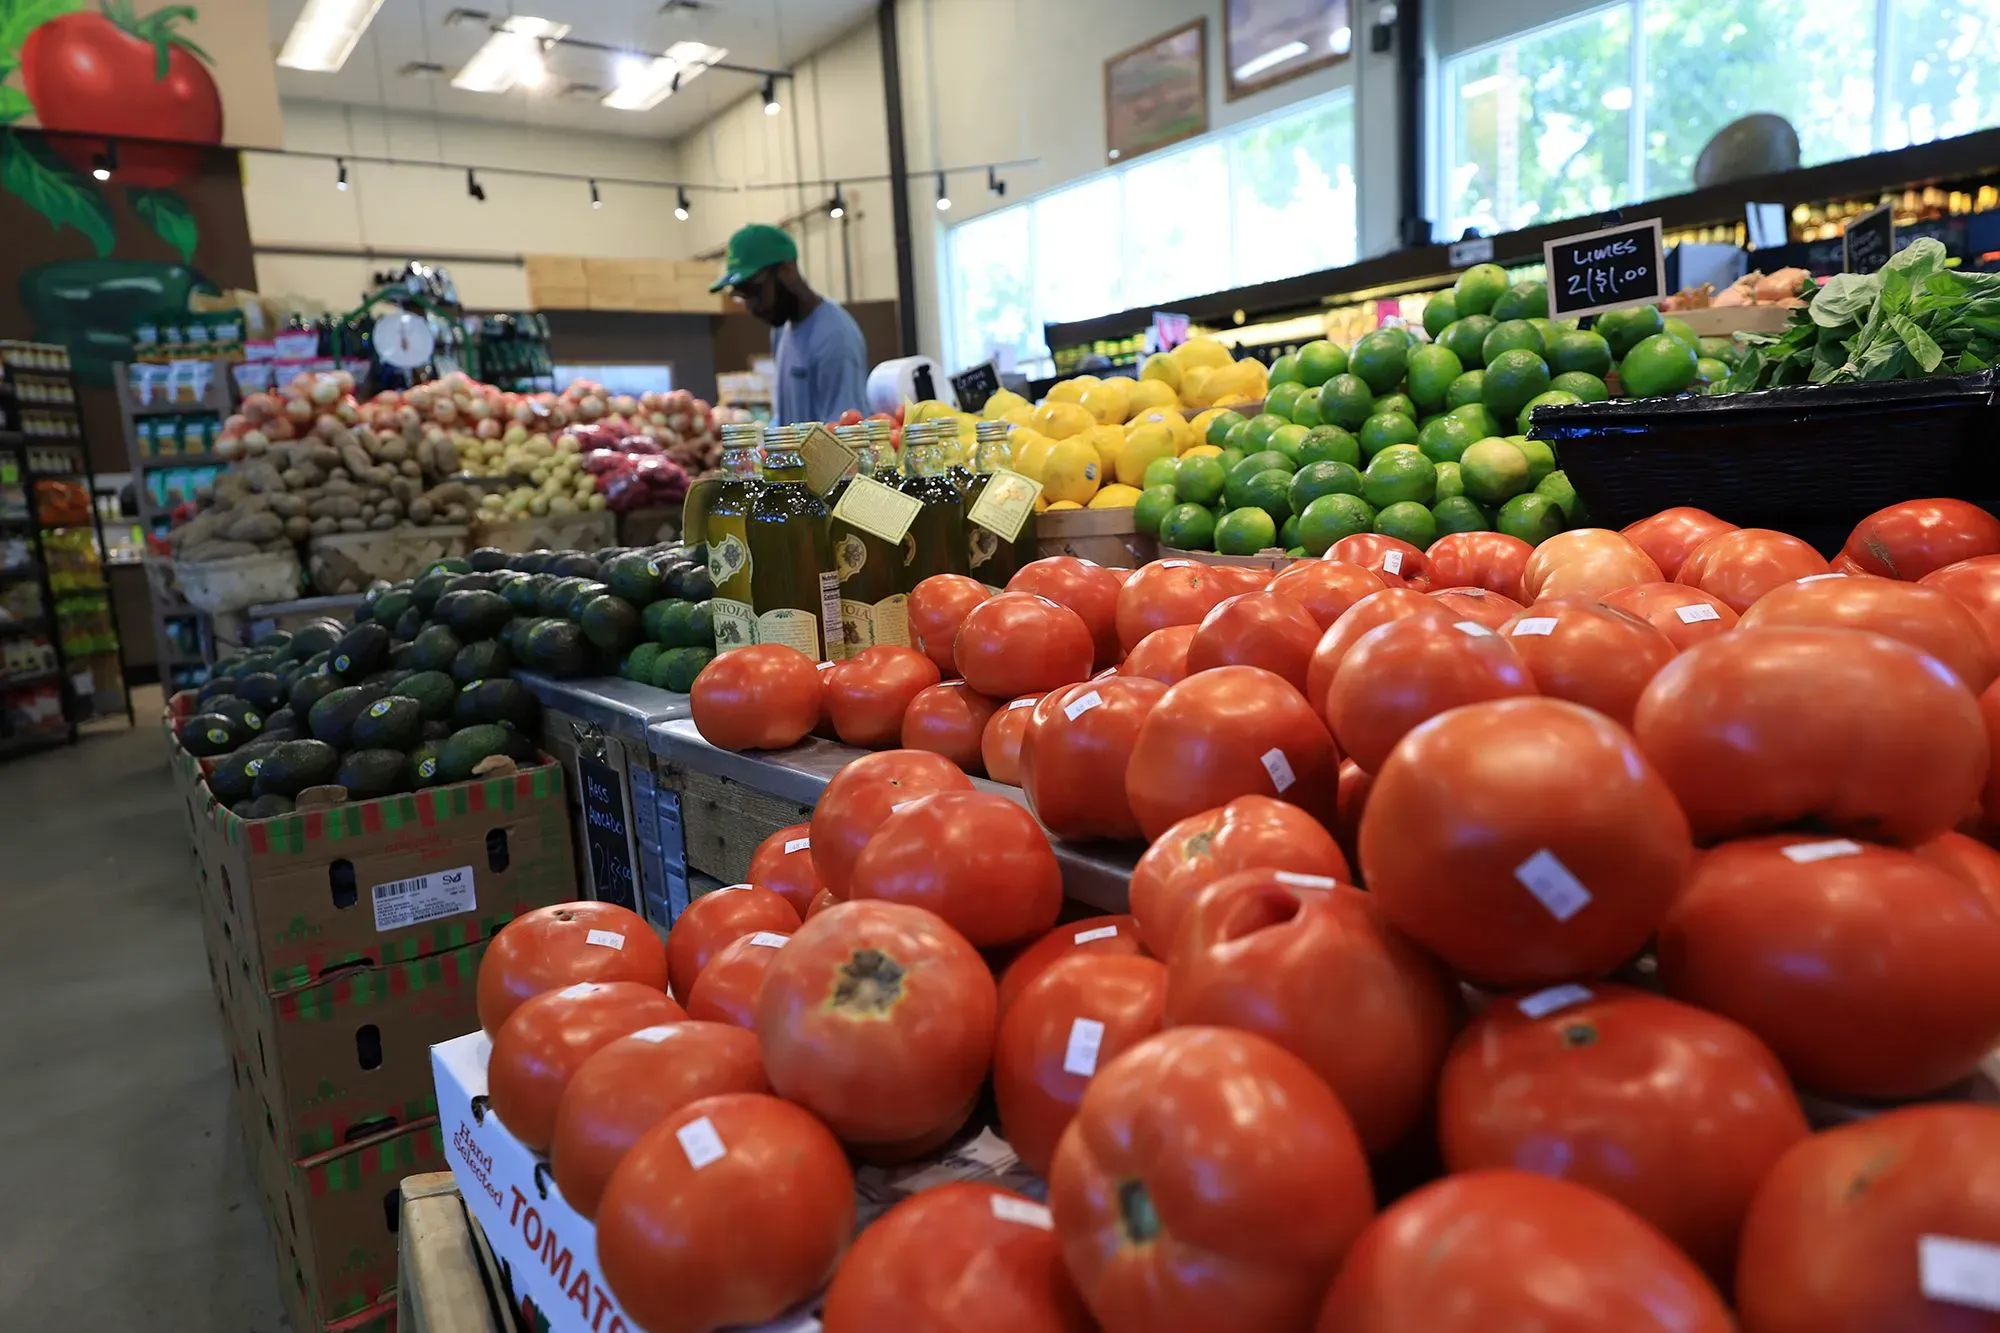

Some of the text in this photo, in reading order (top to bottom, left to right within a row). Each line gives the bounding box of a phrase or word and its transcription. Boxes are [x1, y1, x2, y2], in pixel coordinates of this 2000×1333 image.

[1573, 239, 1637, 264] LIMES
[1567, 266, 1647, 303] 2/$1.00
[453, 1131, 503, 1209] Selected
[459, 1121, 493, 1174] Hand
